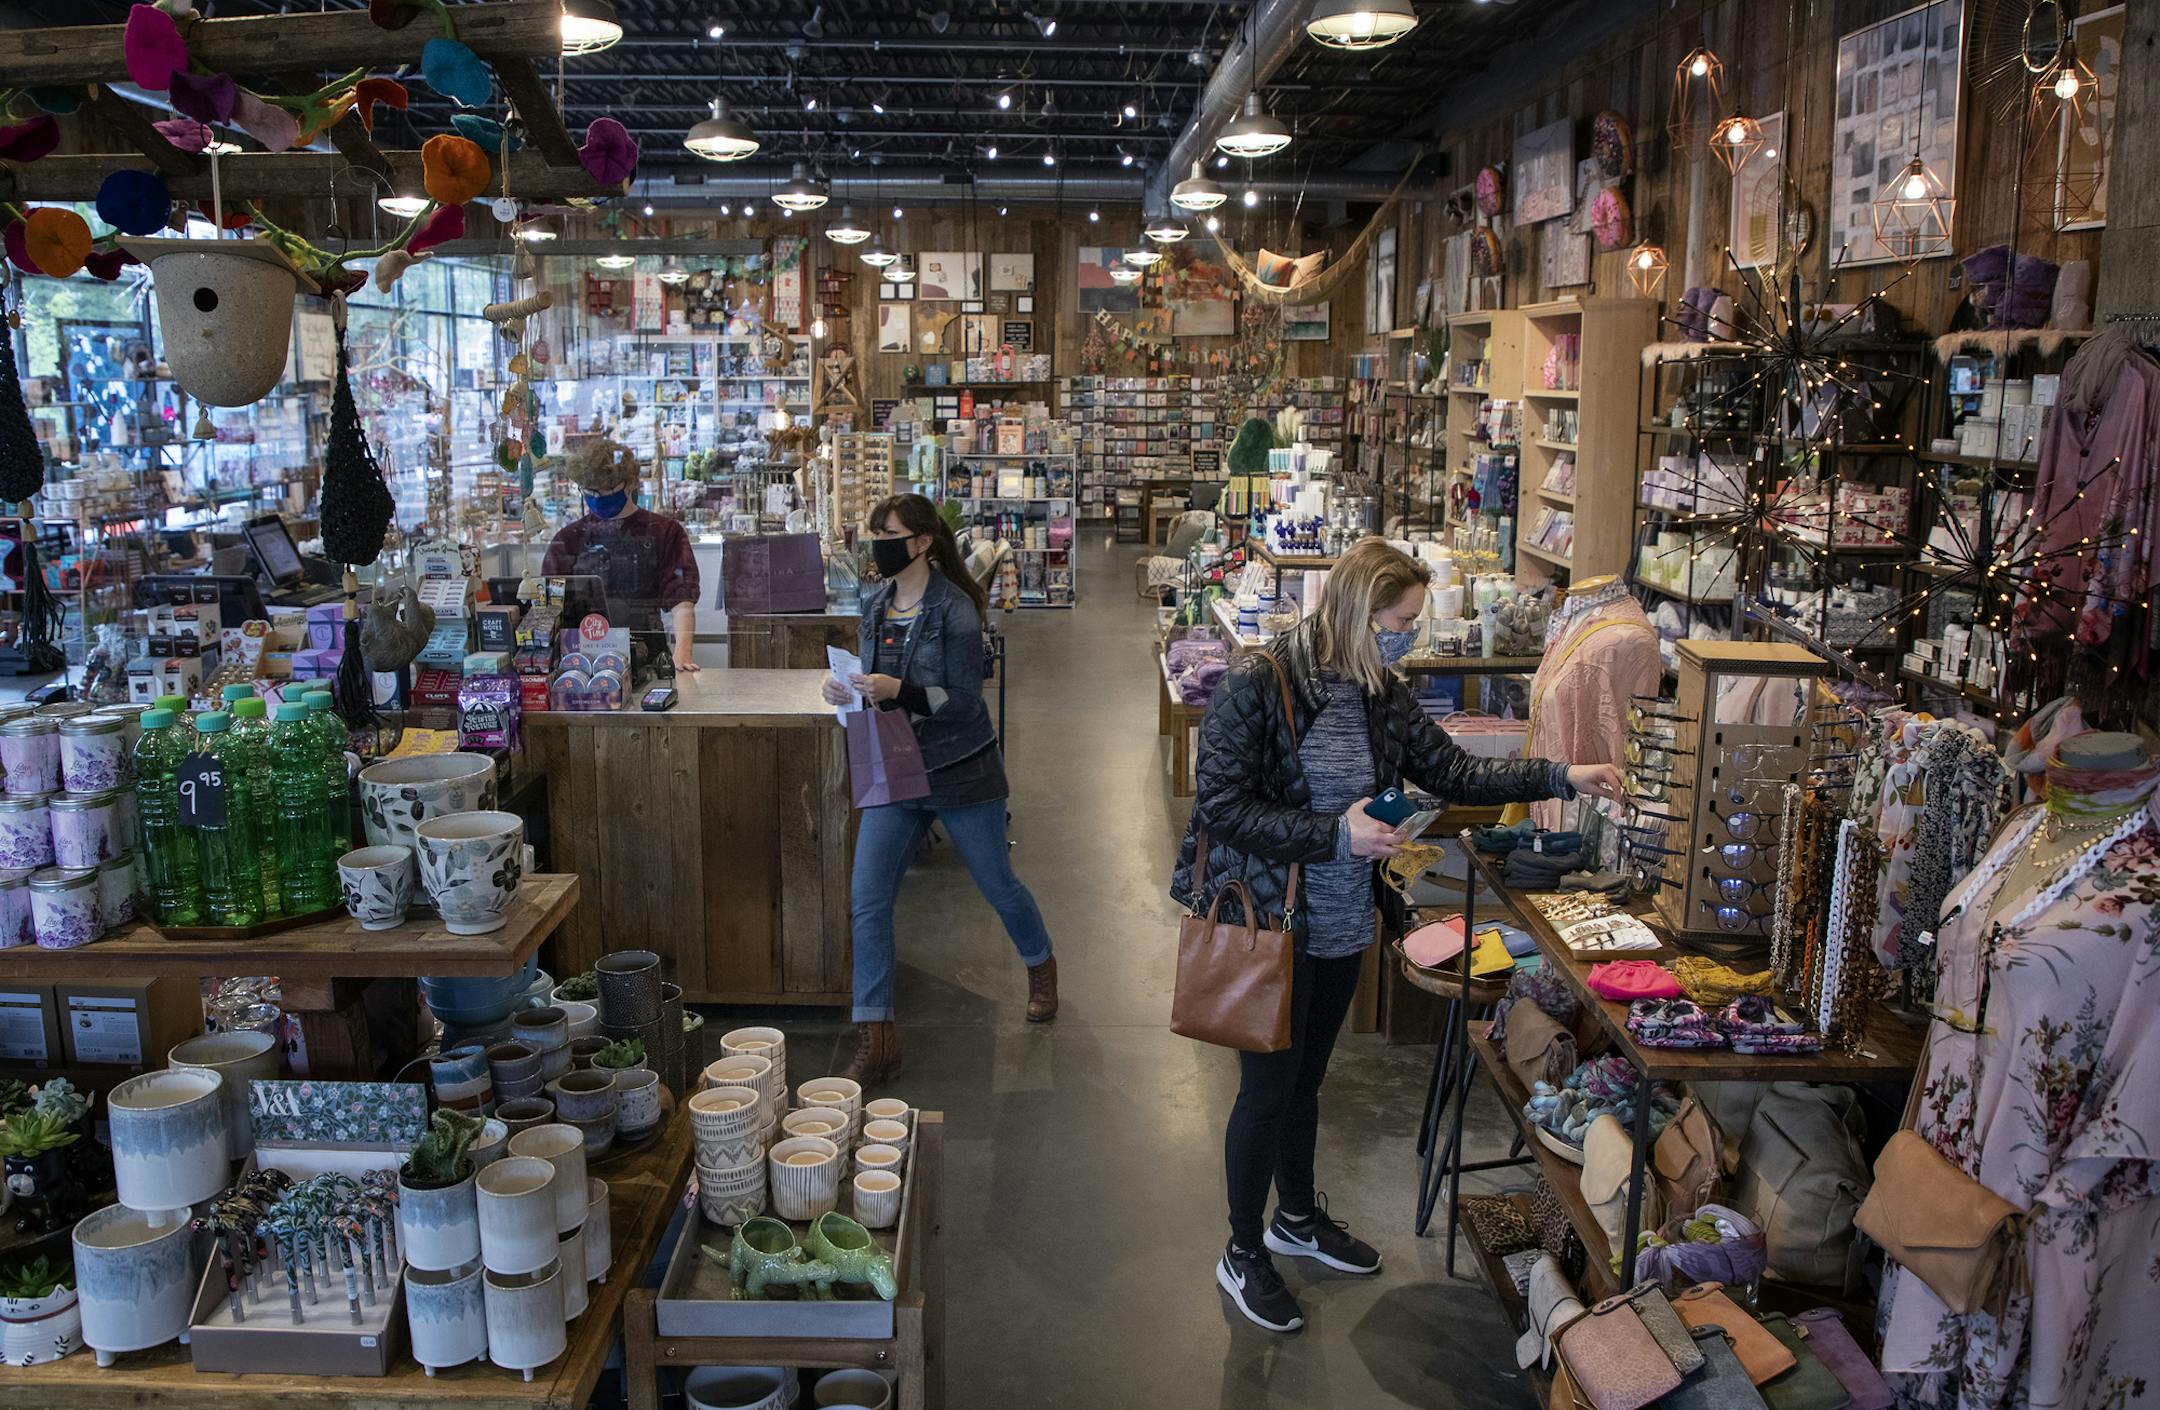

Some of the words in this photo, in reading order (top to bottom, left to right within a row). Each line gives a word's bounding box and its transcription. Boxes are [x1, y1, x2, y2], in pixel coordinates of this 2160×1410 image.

[1095, 307, 1160, 357] HAPPY
[584, 616, 603, 631] City
[424, 692, 451, 700] CLOVE
[253, 1083, 301, 1117] V&A
